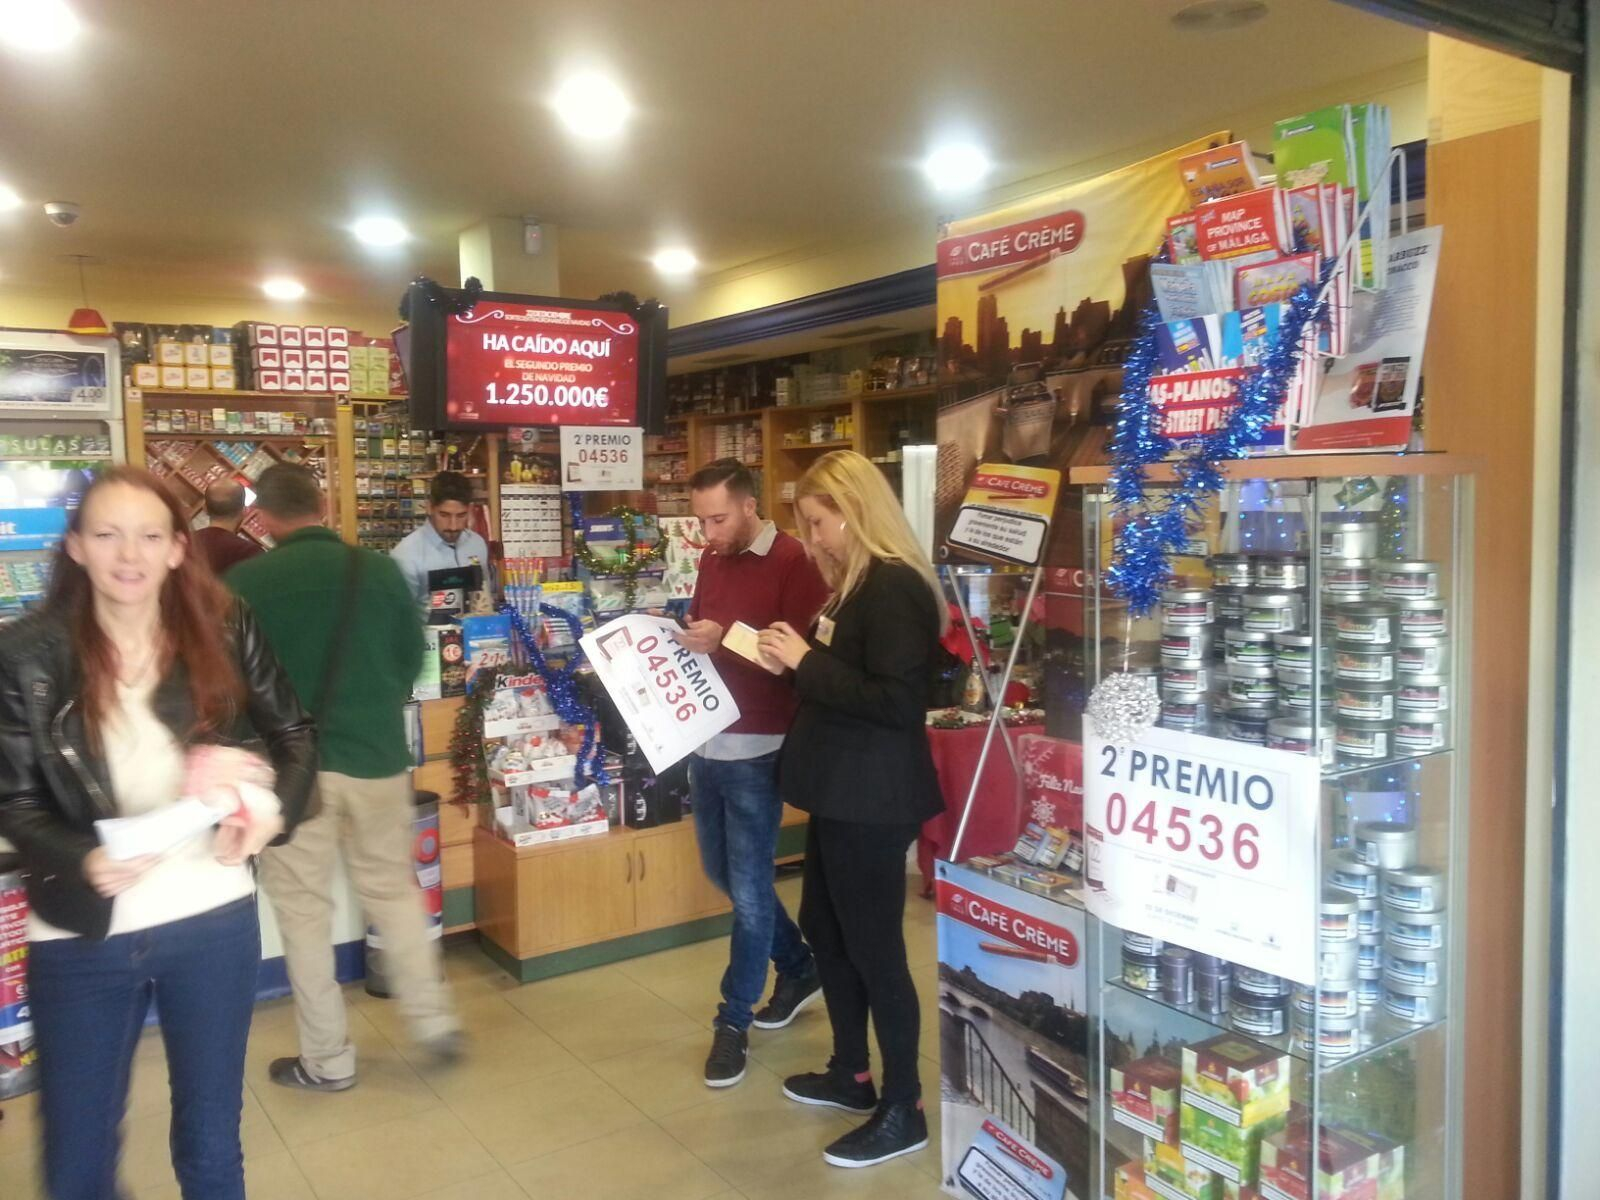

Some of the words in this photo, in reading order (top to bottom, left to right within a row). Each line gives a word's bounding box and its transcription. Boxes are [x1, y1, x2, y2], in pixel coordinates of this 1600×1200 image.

[1220, 208, 1246, 221] MAP
[1207, 217, 1263, 239] PROVINCE
[968, 235, 1011, 262] CAFÉ
[483, 333, 510, 351] HA
[512, 333, 567, 355] CAÍDO
[569, 337, 612, 359] AQUÍ
[515, 360, 559, 372] SEGUNDO
[559, 362, 593, 373] PREMIO
[522, 372, 534, 381] DE
[534, 373, 576, 383] NAVIDAD
[486, 383, 609, 408] 1.250.000€
[585, 434, 631, 446] PREMIO
[579, 448, 629, 463] 04536
[497, 675, 546, 688] Kinde
[636, 635, 697, 722] 04536
[1129, 750, 1274, 811] PREMIO
[1106, 792, 1260, 870] 04536
[968, 901, 1009, 933] CAFÉ
